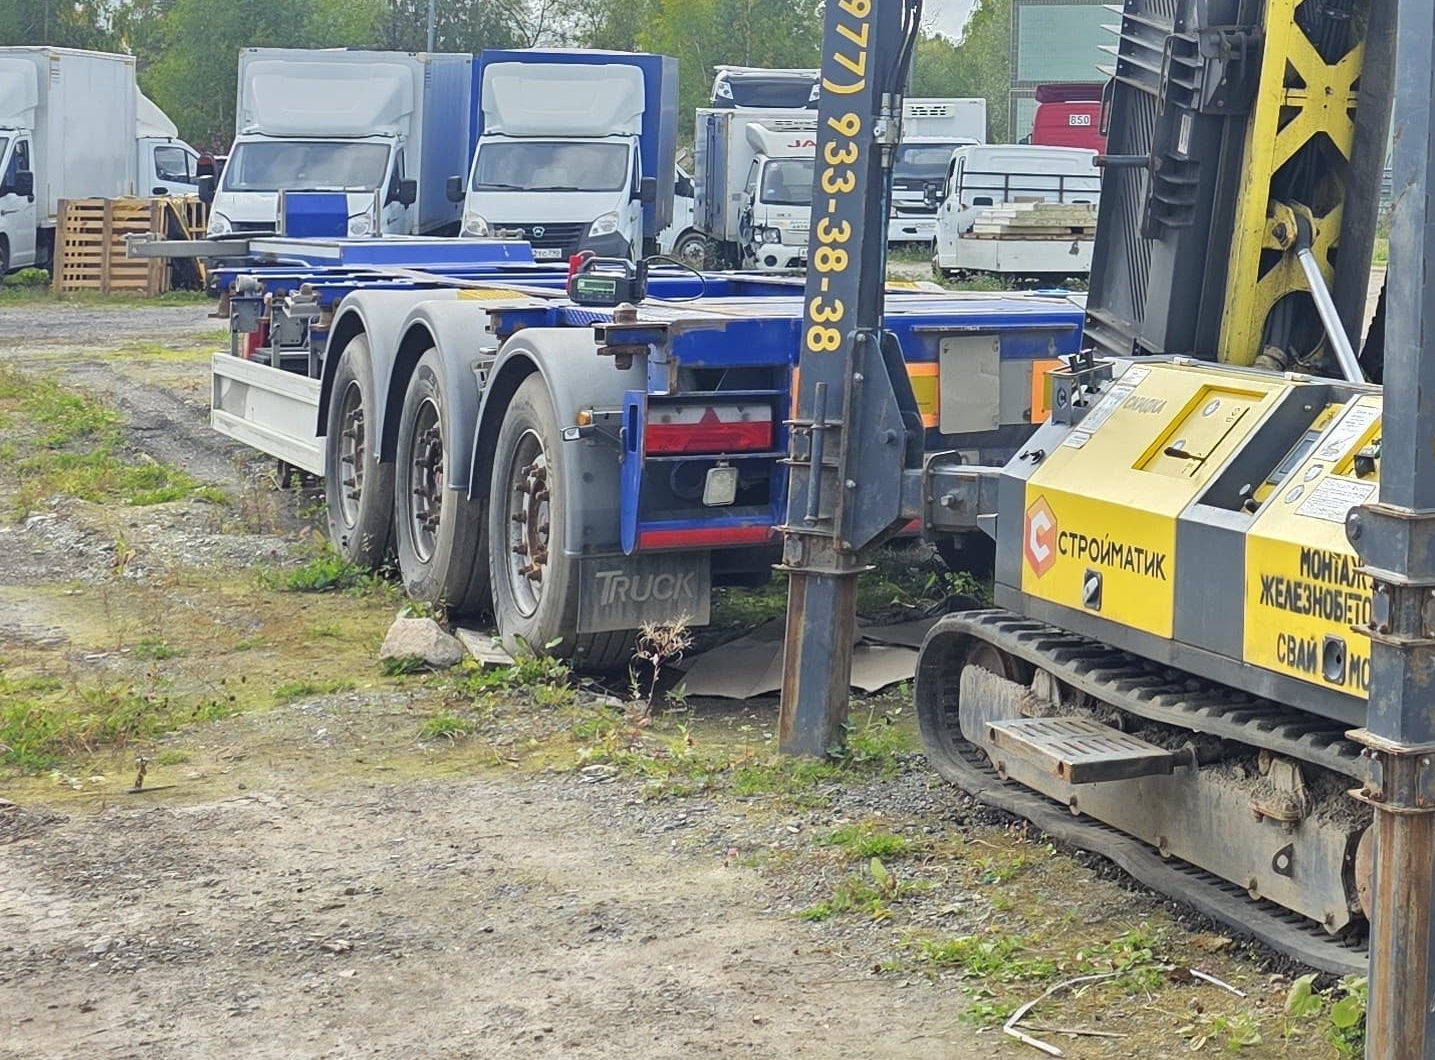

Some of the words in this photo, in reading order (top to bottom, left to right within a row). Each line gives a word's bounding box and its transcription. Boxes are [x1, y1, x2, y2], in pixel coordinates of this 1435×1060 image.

[806, 112, 862, 352] 933-38-38
[1058, 531, 1167, 581] СТРОЙМАТИК
[1300, 546, 1368, 591] МОНТАЖ
[595, 570, 696, 606] TRUCK
[1277, 632, 1319, 675] СВАЙ
